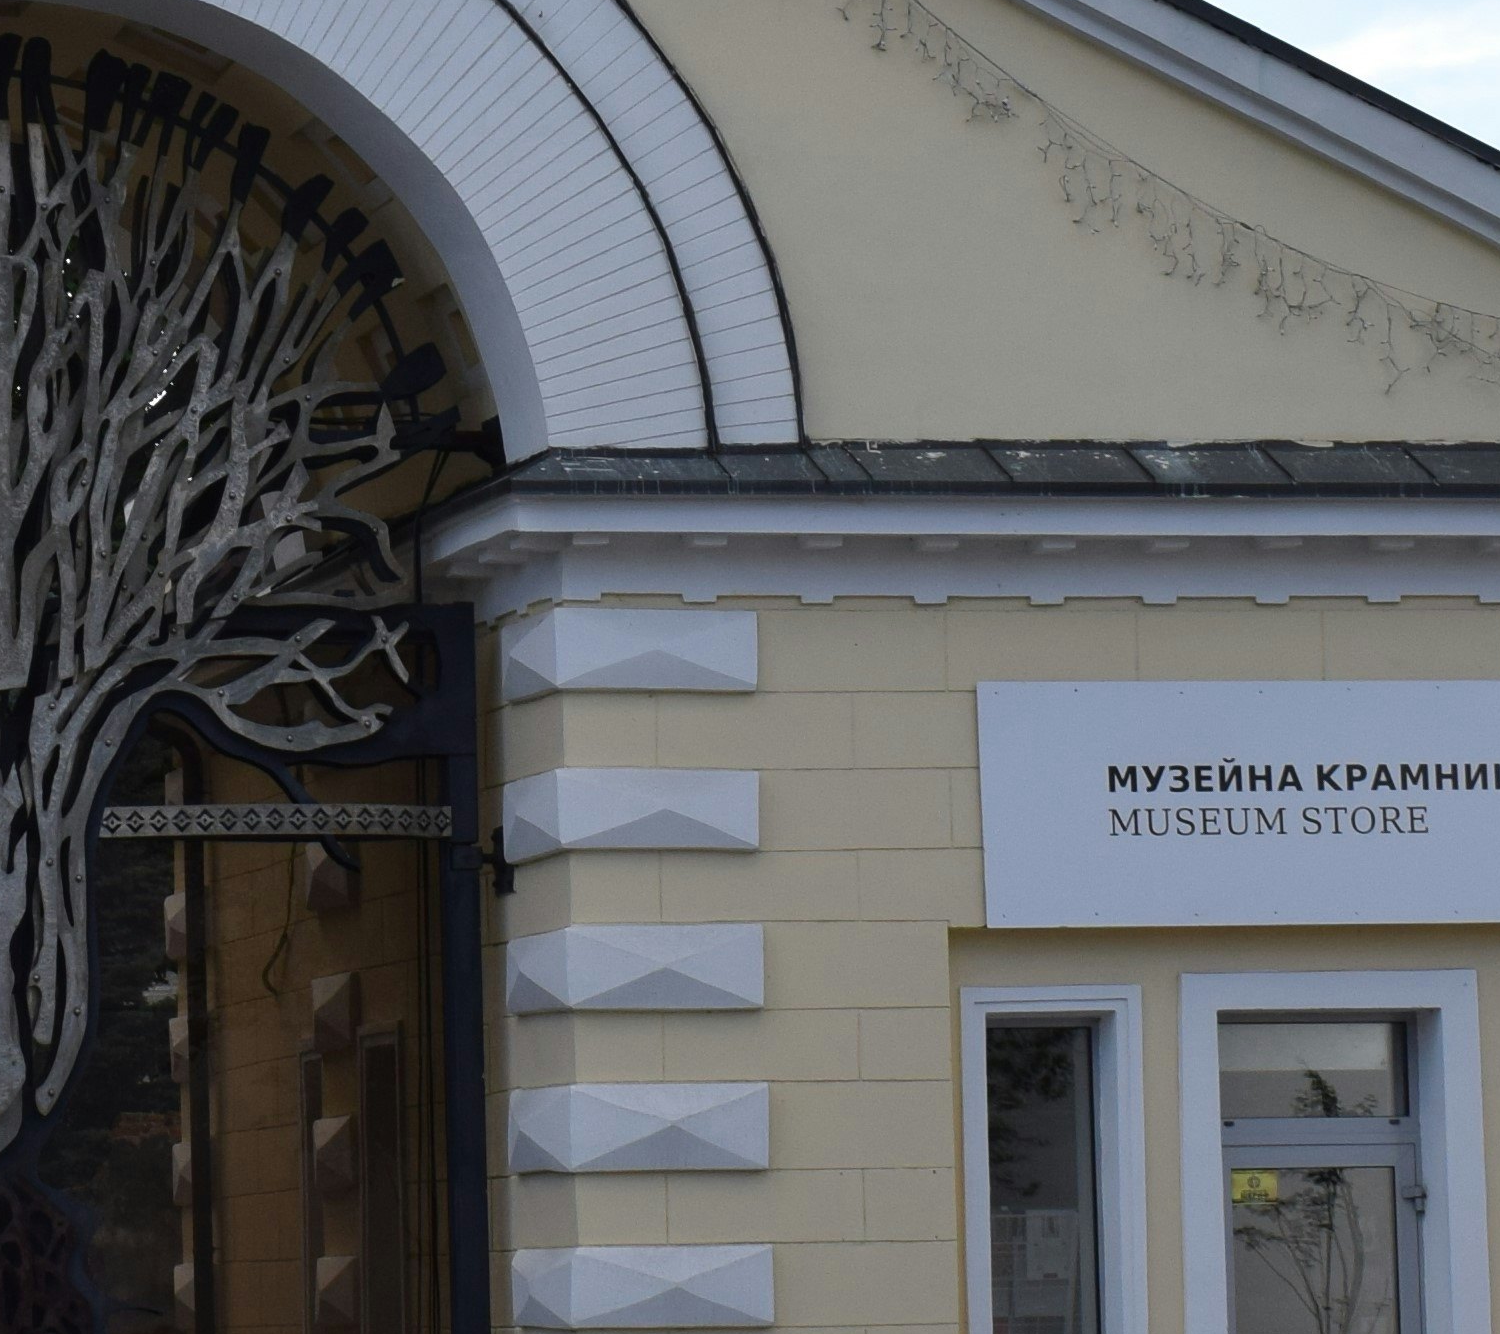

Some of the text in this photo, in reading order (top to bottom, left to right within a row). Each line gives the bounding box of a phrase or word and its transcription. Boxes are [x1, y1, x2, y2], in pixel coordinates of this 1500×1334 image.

[1107, 758, 1303, 793] МУЗЕЙНА
[1109, 806, 1430, 836] MUSEUM STORE
